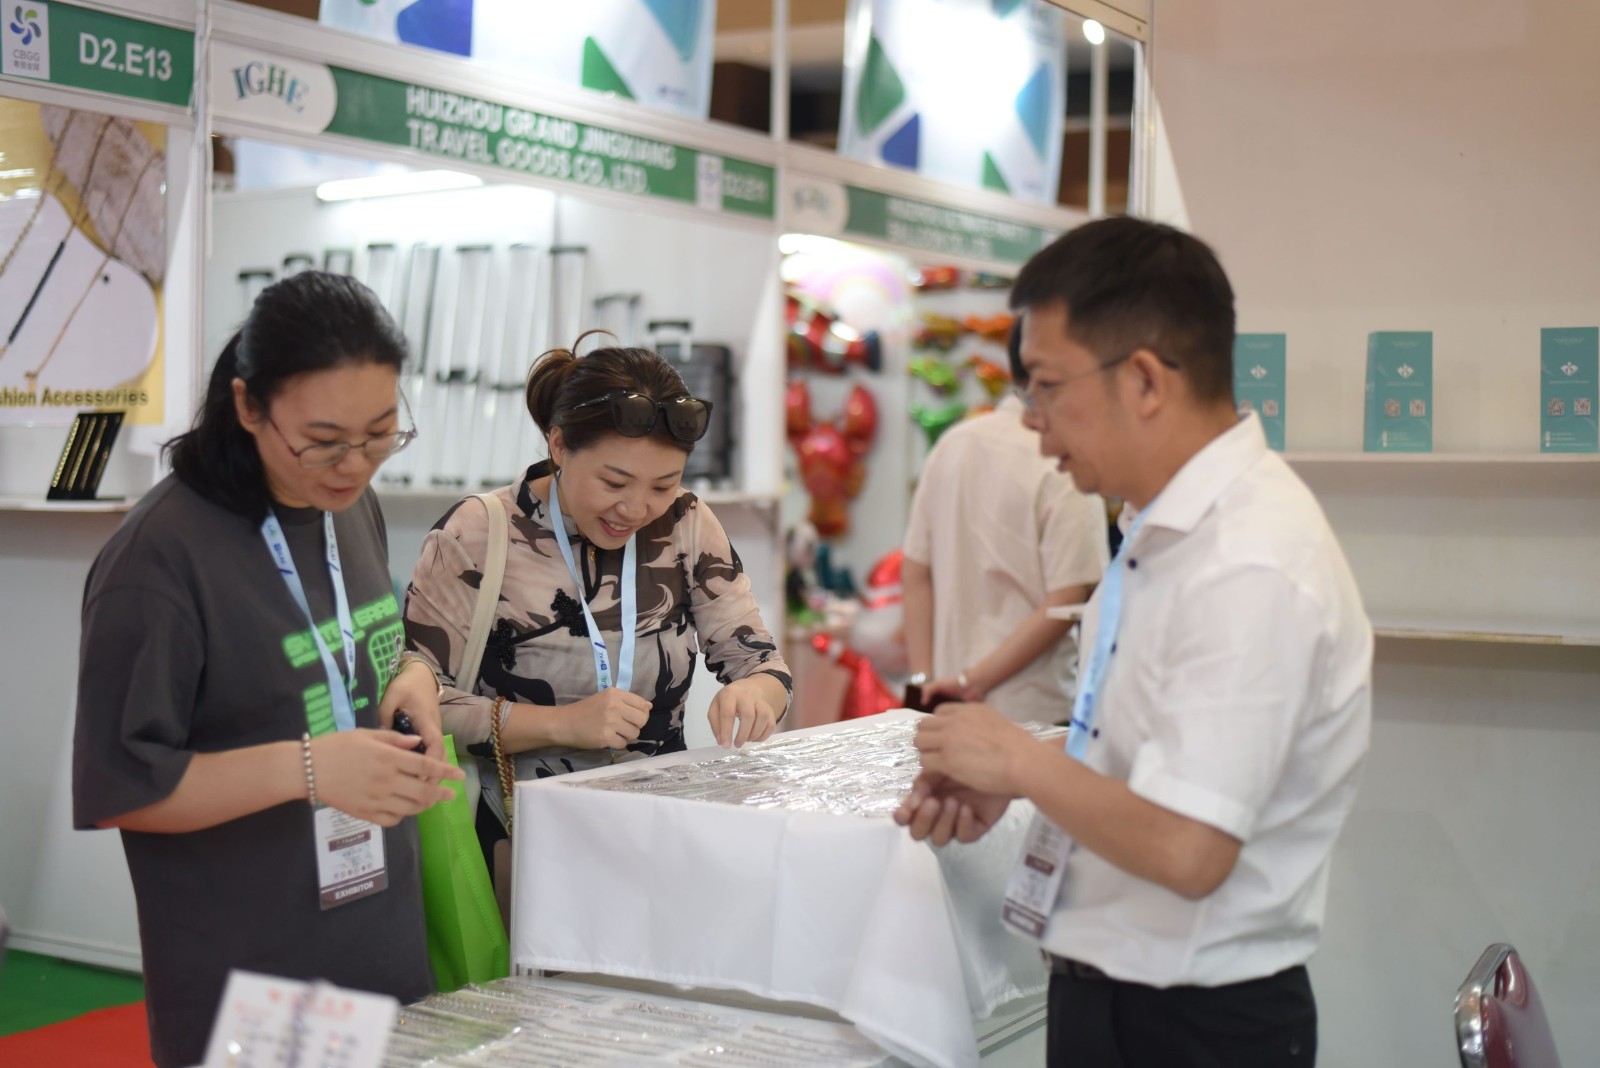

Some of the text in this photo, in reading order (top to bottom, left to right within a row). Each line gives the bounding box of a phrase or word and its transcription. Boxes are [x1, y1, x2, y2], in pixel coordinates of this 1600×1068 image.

[13, 48, 40, 63] CBGG
[79, 32, 173, 82] D2.E13
[231, 60, 310, 113] IGHE
[406, 85, 504, 132] HUIZHOU
[505, 109, 578, 149] GRAND
[406, 117, 494, 163] TRAVEL
[496, 137, 571, 179] GOODS
[41, 385, 148, 407] Accessories
[335, 881, 374, 900] EXHIBITOR
